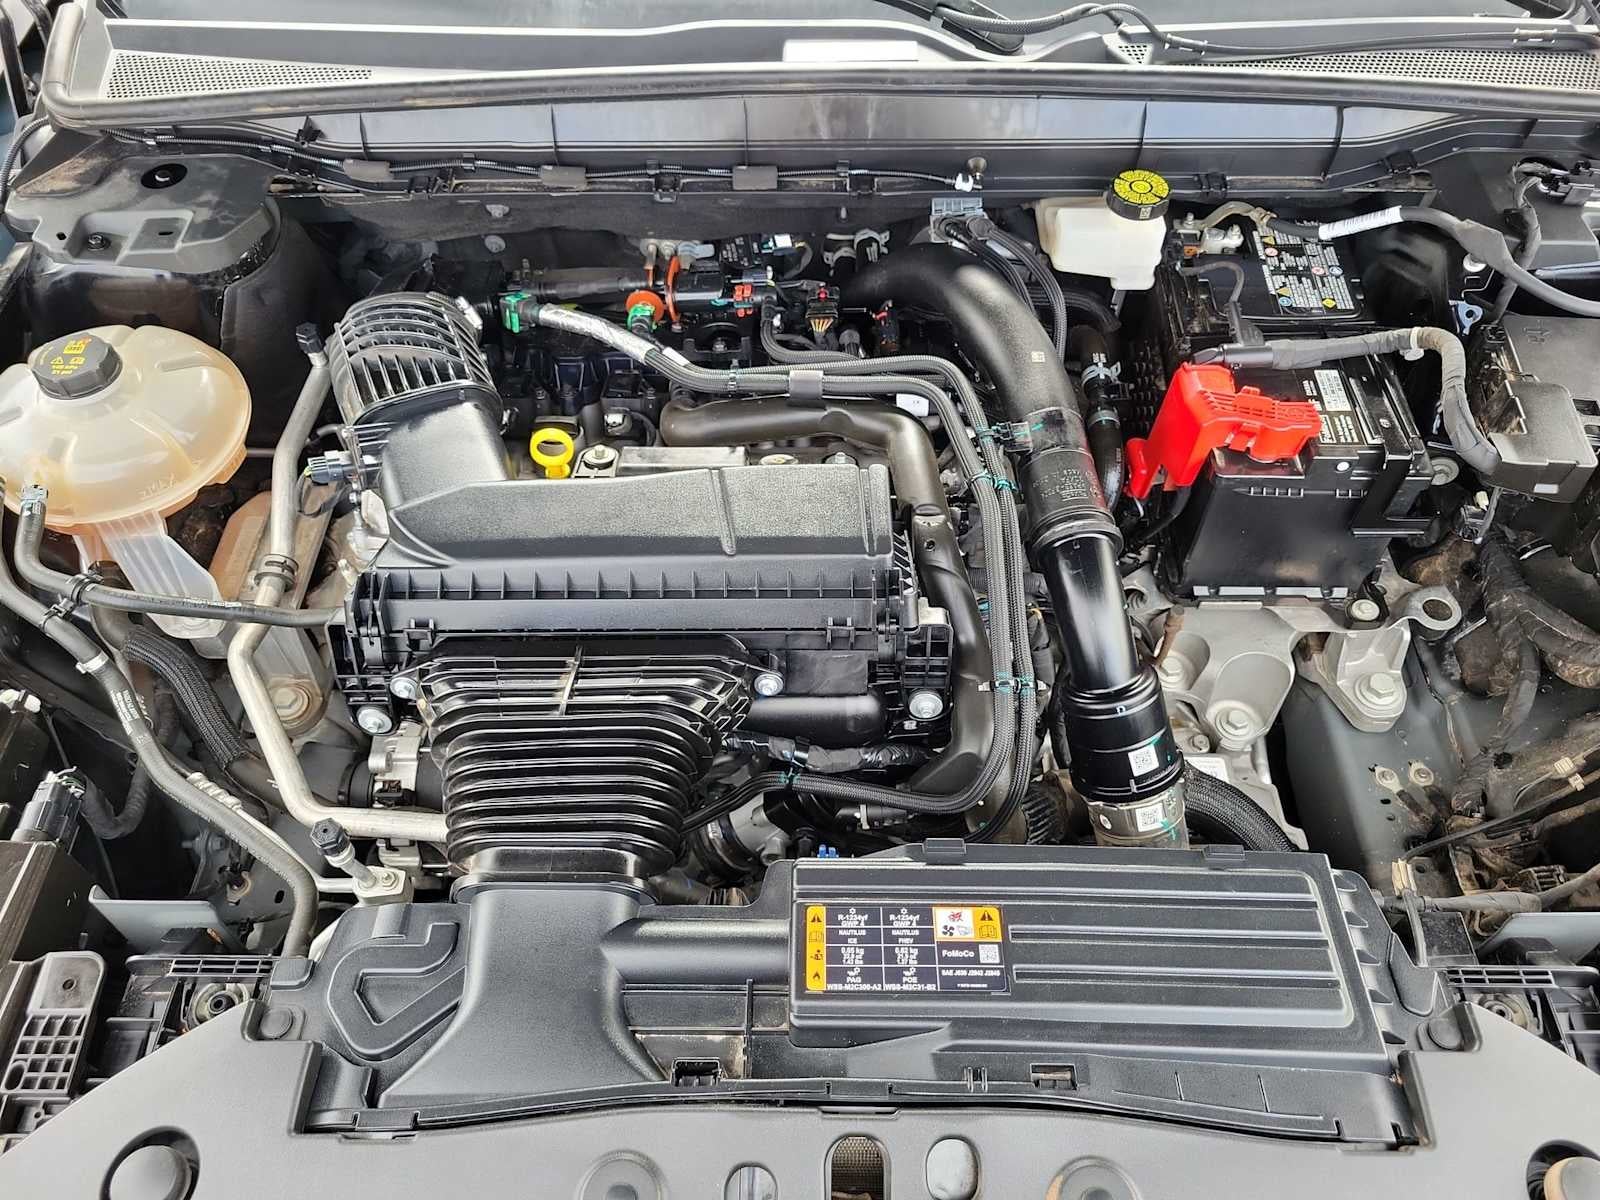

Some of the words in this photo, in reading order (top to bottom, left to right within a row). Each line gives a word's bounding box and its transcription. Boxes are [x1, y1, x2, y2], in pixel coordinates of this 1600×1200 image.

[838, 914, 868, 922] R-1234yf
[889, 914, 920, 922] R-1234yf
[942, 949, 975, 958] FoMoCo
